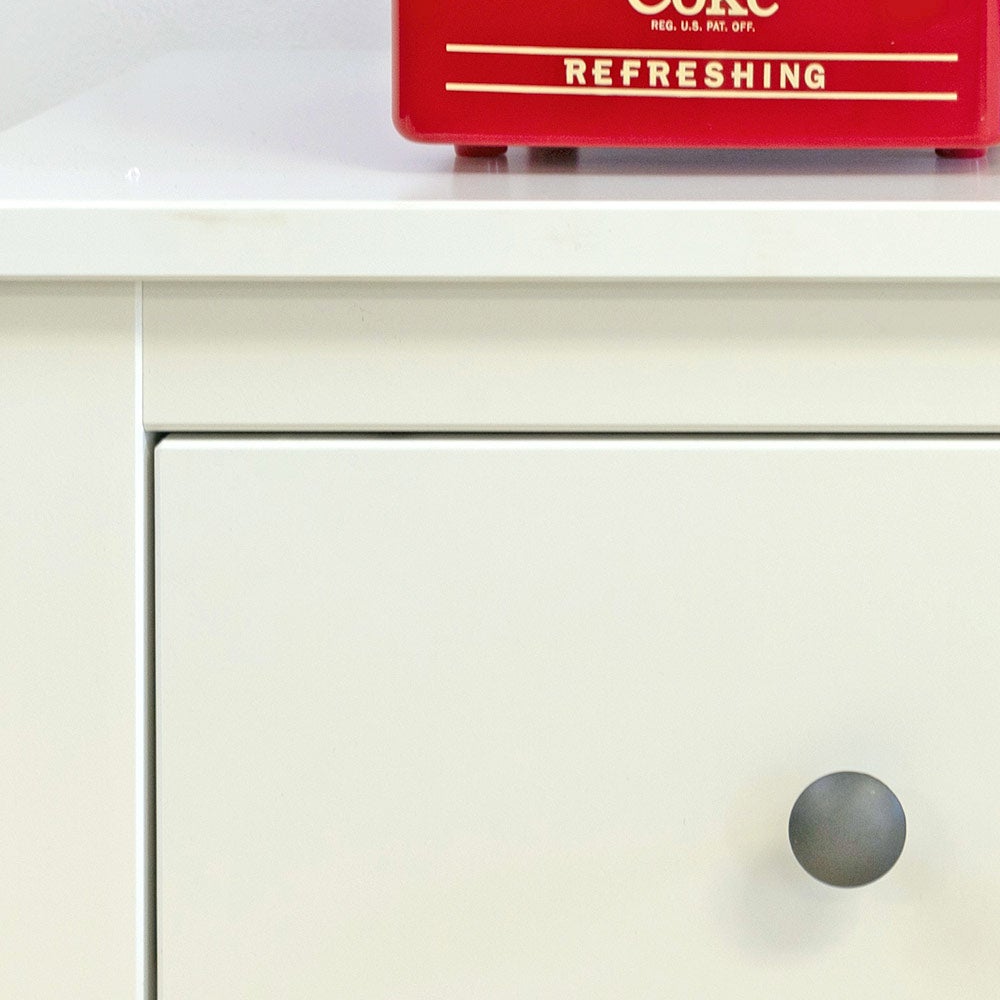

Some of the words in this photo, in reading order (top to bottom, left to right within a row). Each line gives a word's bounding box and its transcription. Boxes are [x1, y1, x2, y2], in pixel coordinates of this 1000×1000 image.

[650, 19, 677, 32] REG.
[680, 20, 703, 32] U.S.
[706, 20, 728, 32] PAT.
[731, 21, 756, 33] OFF.
[563, 57, 826, 90] REFRESHING
